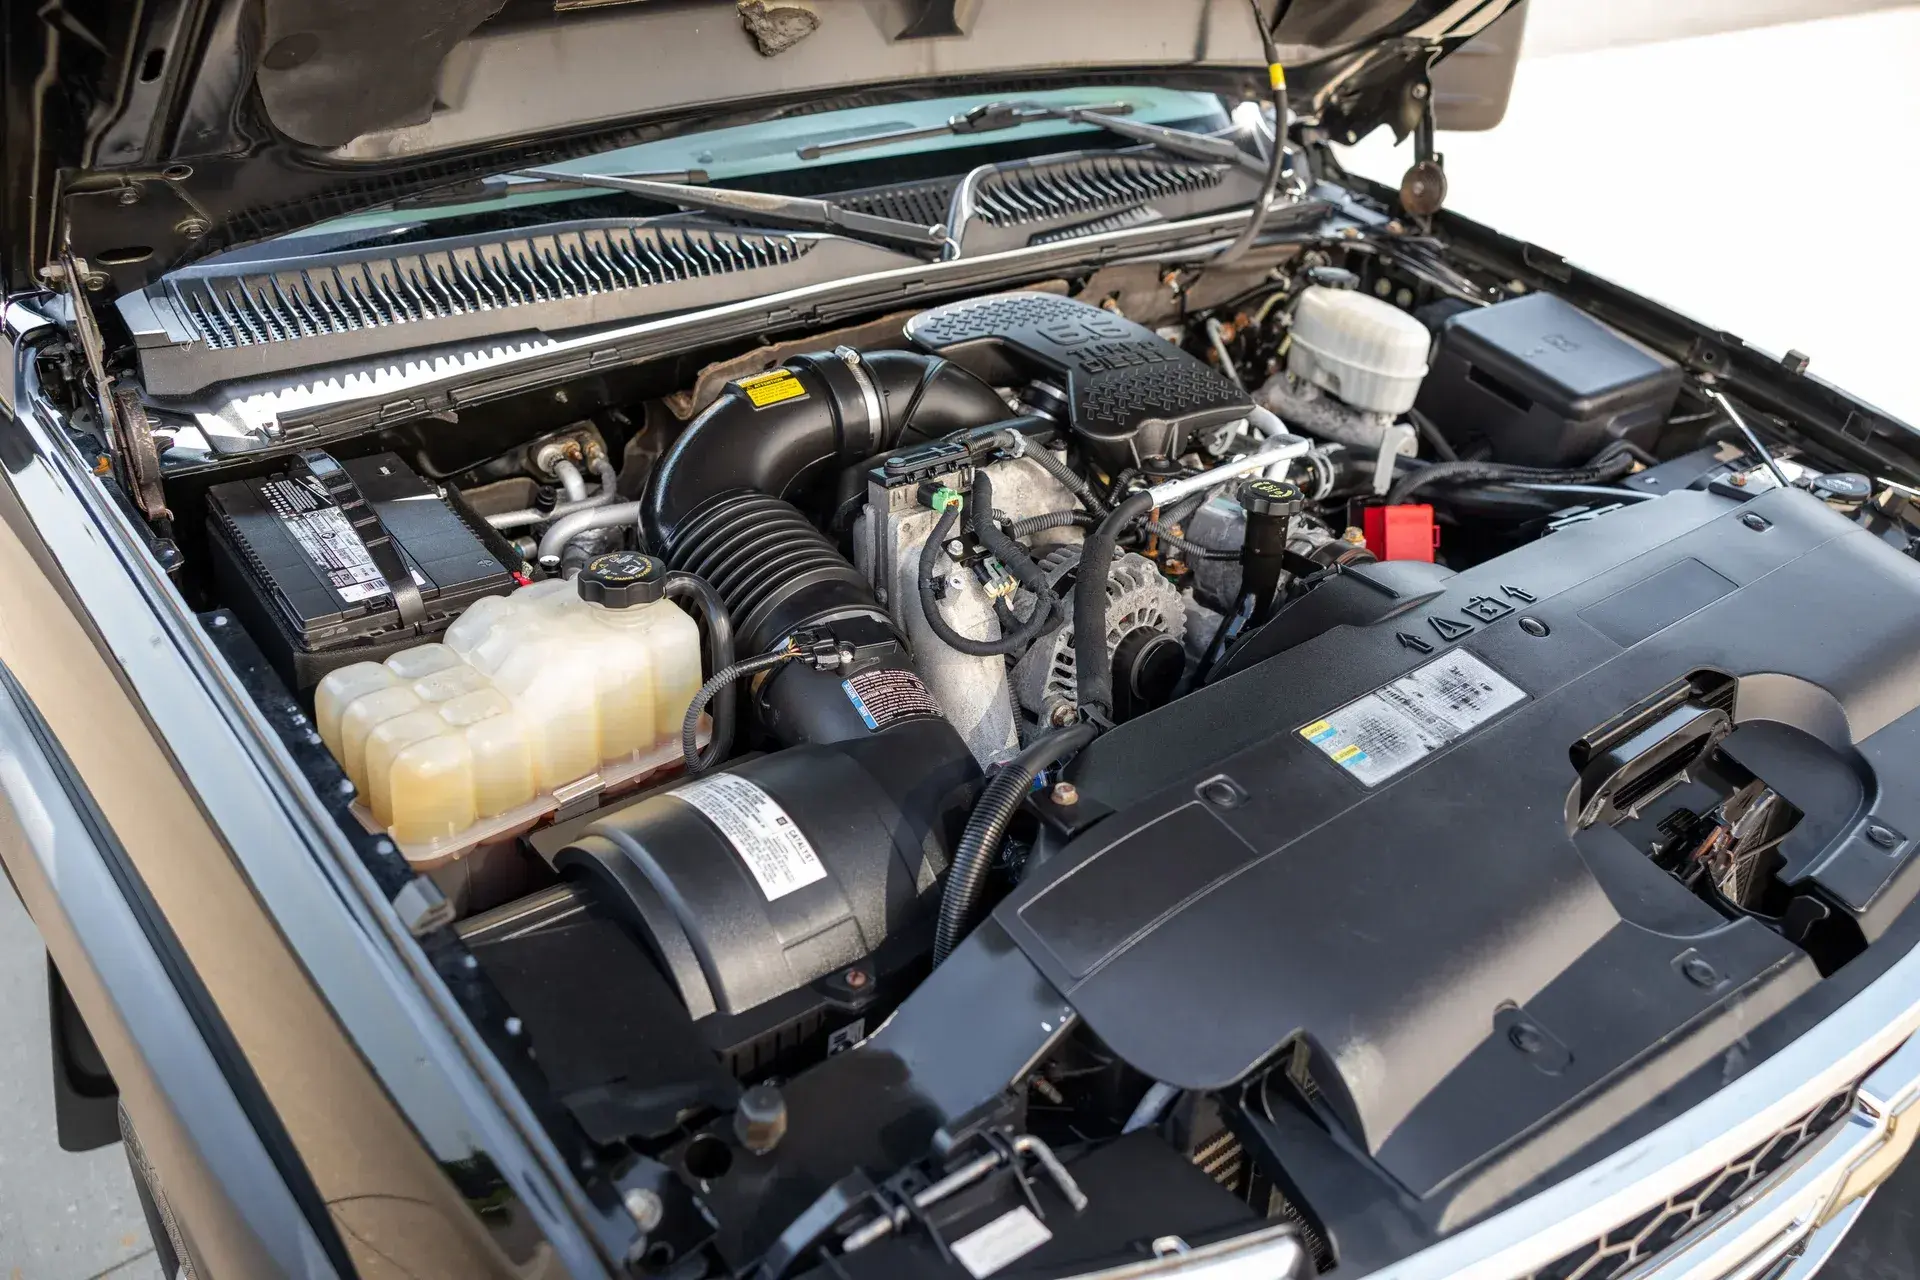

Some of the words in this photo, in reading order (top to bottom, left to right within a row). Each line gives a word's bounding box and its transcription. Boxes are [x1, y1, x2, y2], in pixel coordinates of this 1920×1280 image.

[1036, 321, 1131, 346] 6.6
[1067, 341, 1161, 361] TURBO
[1079, 350, 1180, 373] DIESEL
[754, 377, 784, 388] ATTENTION
[850, 675, 865, 683] DIESEL
[788, 829, 815, 863] CATALYST
